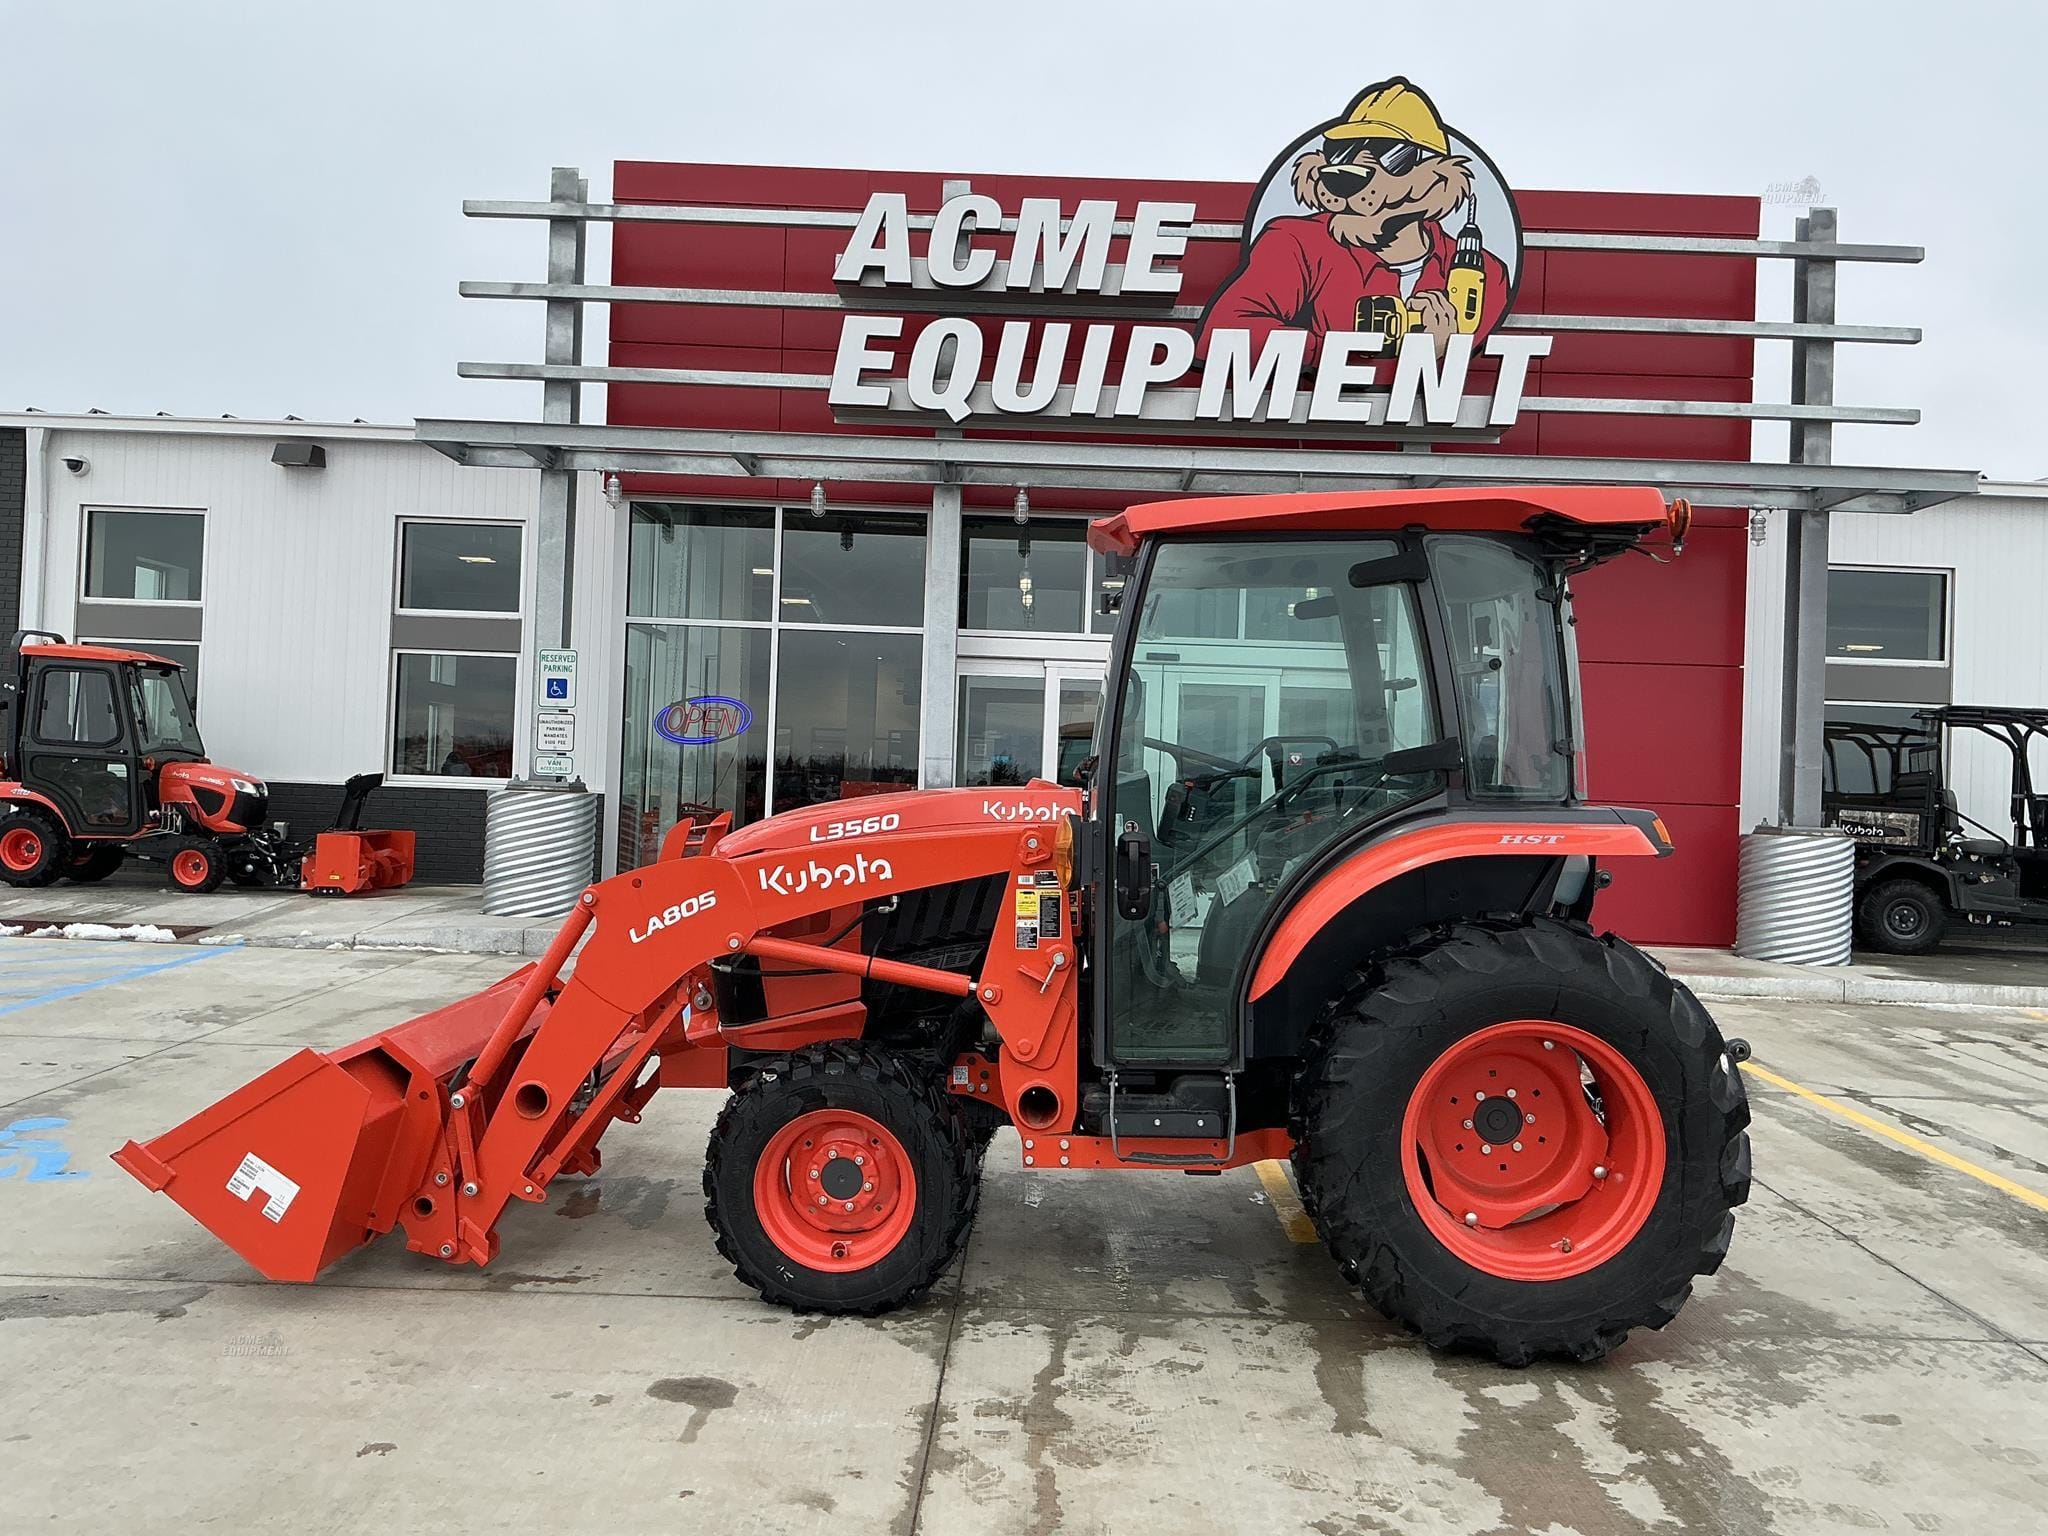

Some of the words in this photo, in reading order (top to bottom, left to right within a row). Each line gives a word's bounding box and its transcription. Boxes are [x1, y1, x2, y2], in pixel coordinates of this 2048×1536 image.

[832, 192, 1196, 294] ACME
[828, 315, 1553, 426] EQUIPMENT
[541, 654, 576, 663] RESERVED
[543, 664, 573, 673] PARKING
[666, 704, 739, 736] OPEN
[547, 759, 562, 767] VAN
[809, 813, 900, 843] L3560
[1498, 834, 1566, 844] HST
[1842, 824, 1884, 836] Kubota
[758, 853, 893, 896] Kubota
[628, 890, 718, 945] LA805
